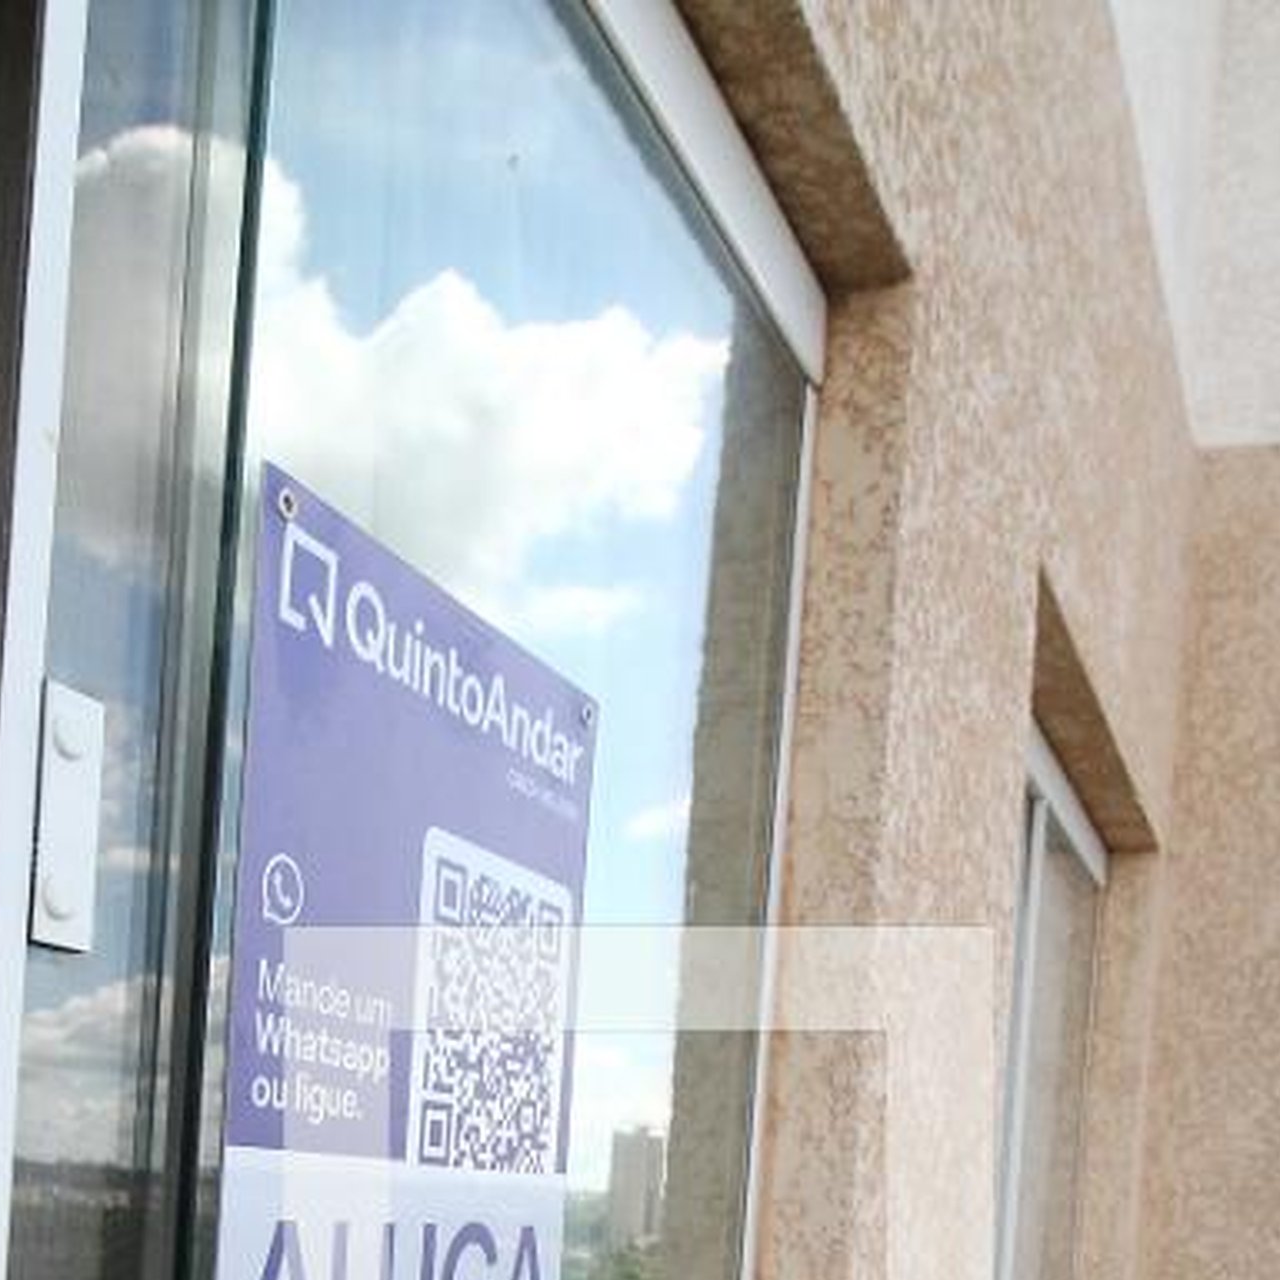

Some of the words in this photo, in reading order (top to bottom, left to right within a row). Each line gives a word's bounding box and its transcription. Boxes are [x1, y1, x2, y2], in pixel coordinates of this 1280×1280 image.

[346, 580, 584, 786] QuintoAndar
[258, 958, 351, 1019] Mande
[256, 1007, 390, 1084] Whatsapp
[252, 1075, 287, 1109] ou
[295, 1071, 362, 1125] ligue.
